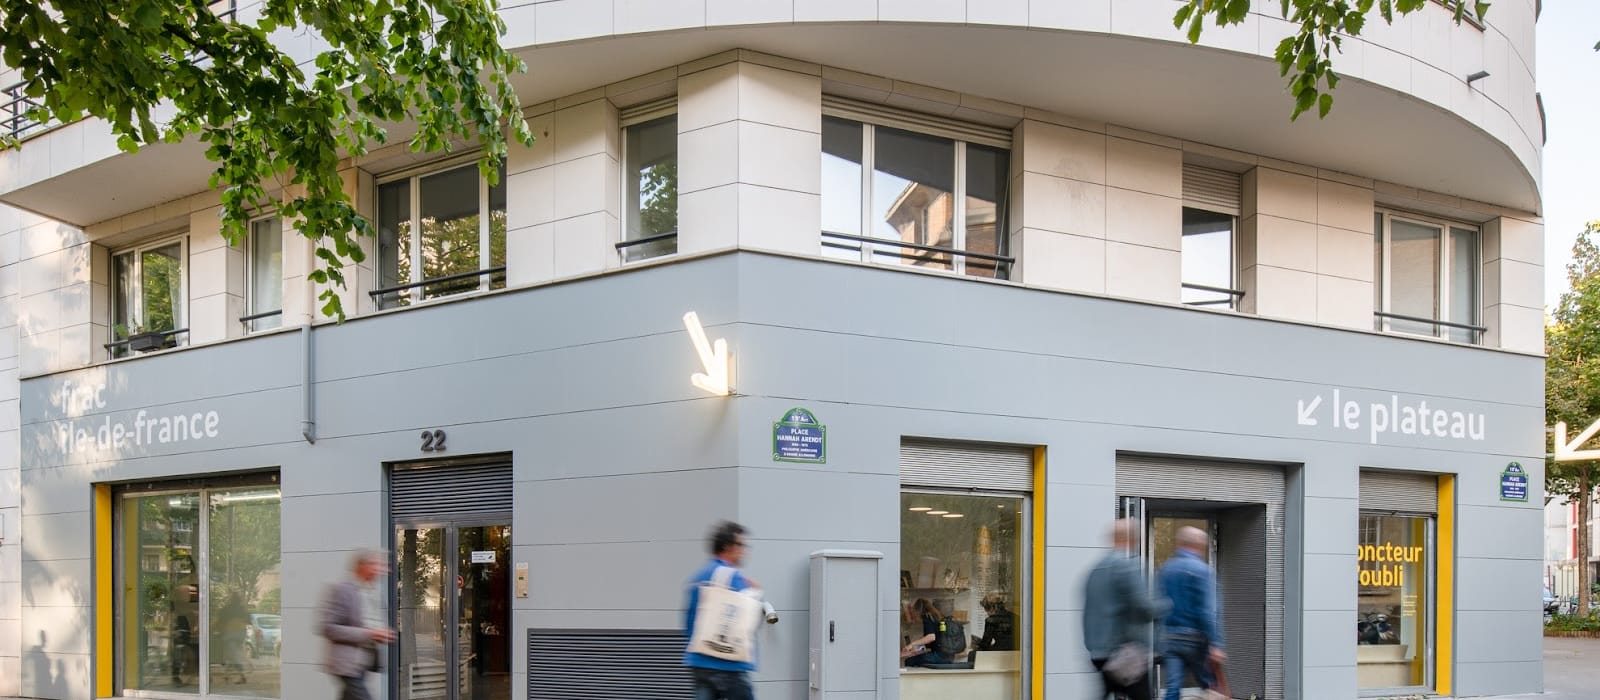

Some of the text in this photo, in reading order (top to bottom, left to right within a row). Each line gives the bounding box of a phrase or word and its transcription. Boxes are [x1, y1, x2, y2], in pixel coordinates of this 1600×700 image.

[61, 380, 106, 413] frac
[1333, 388, 1485, 444] le plateau
[420, 429, 447, 452] 22
